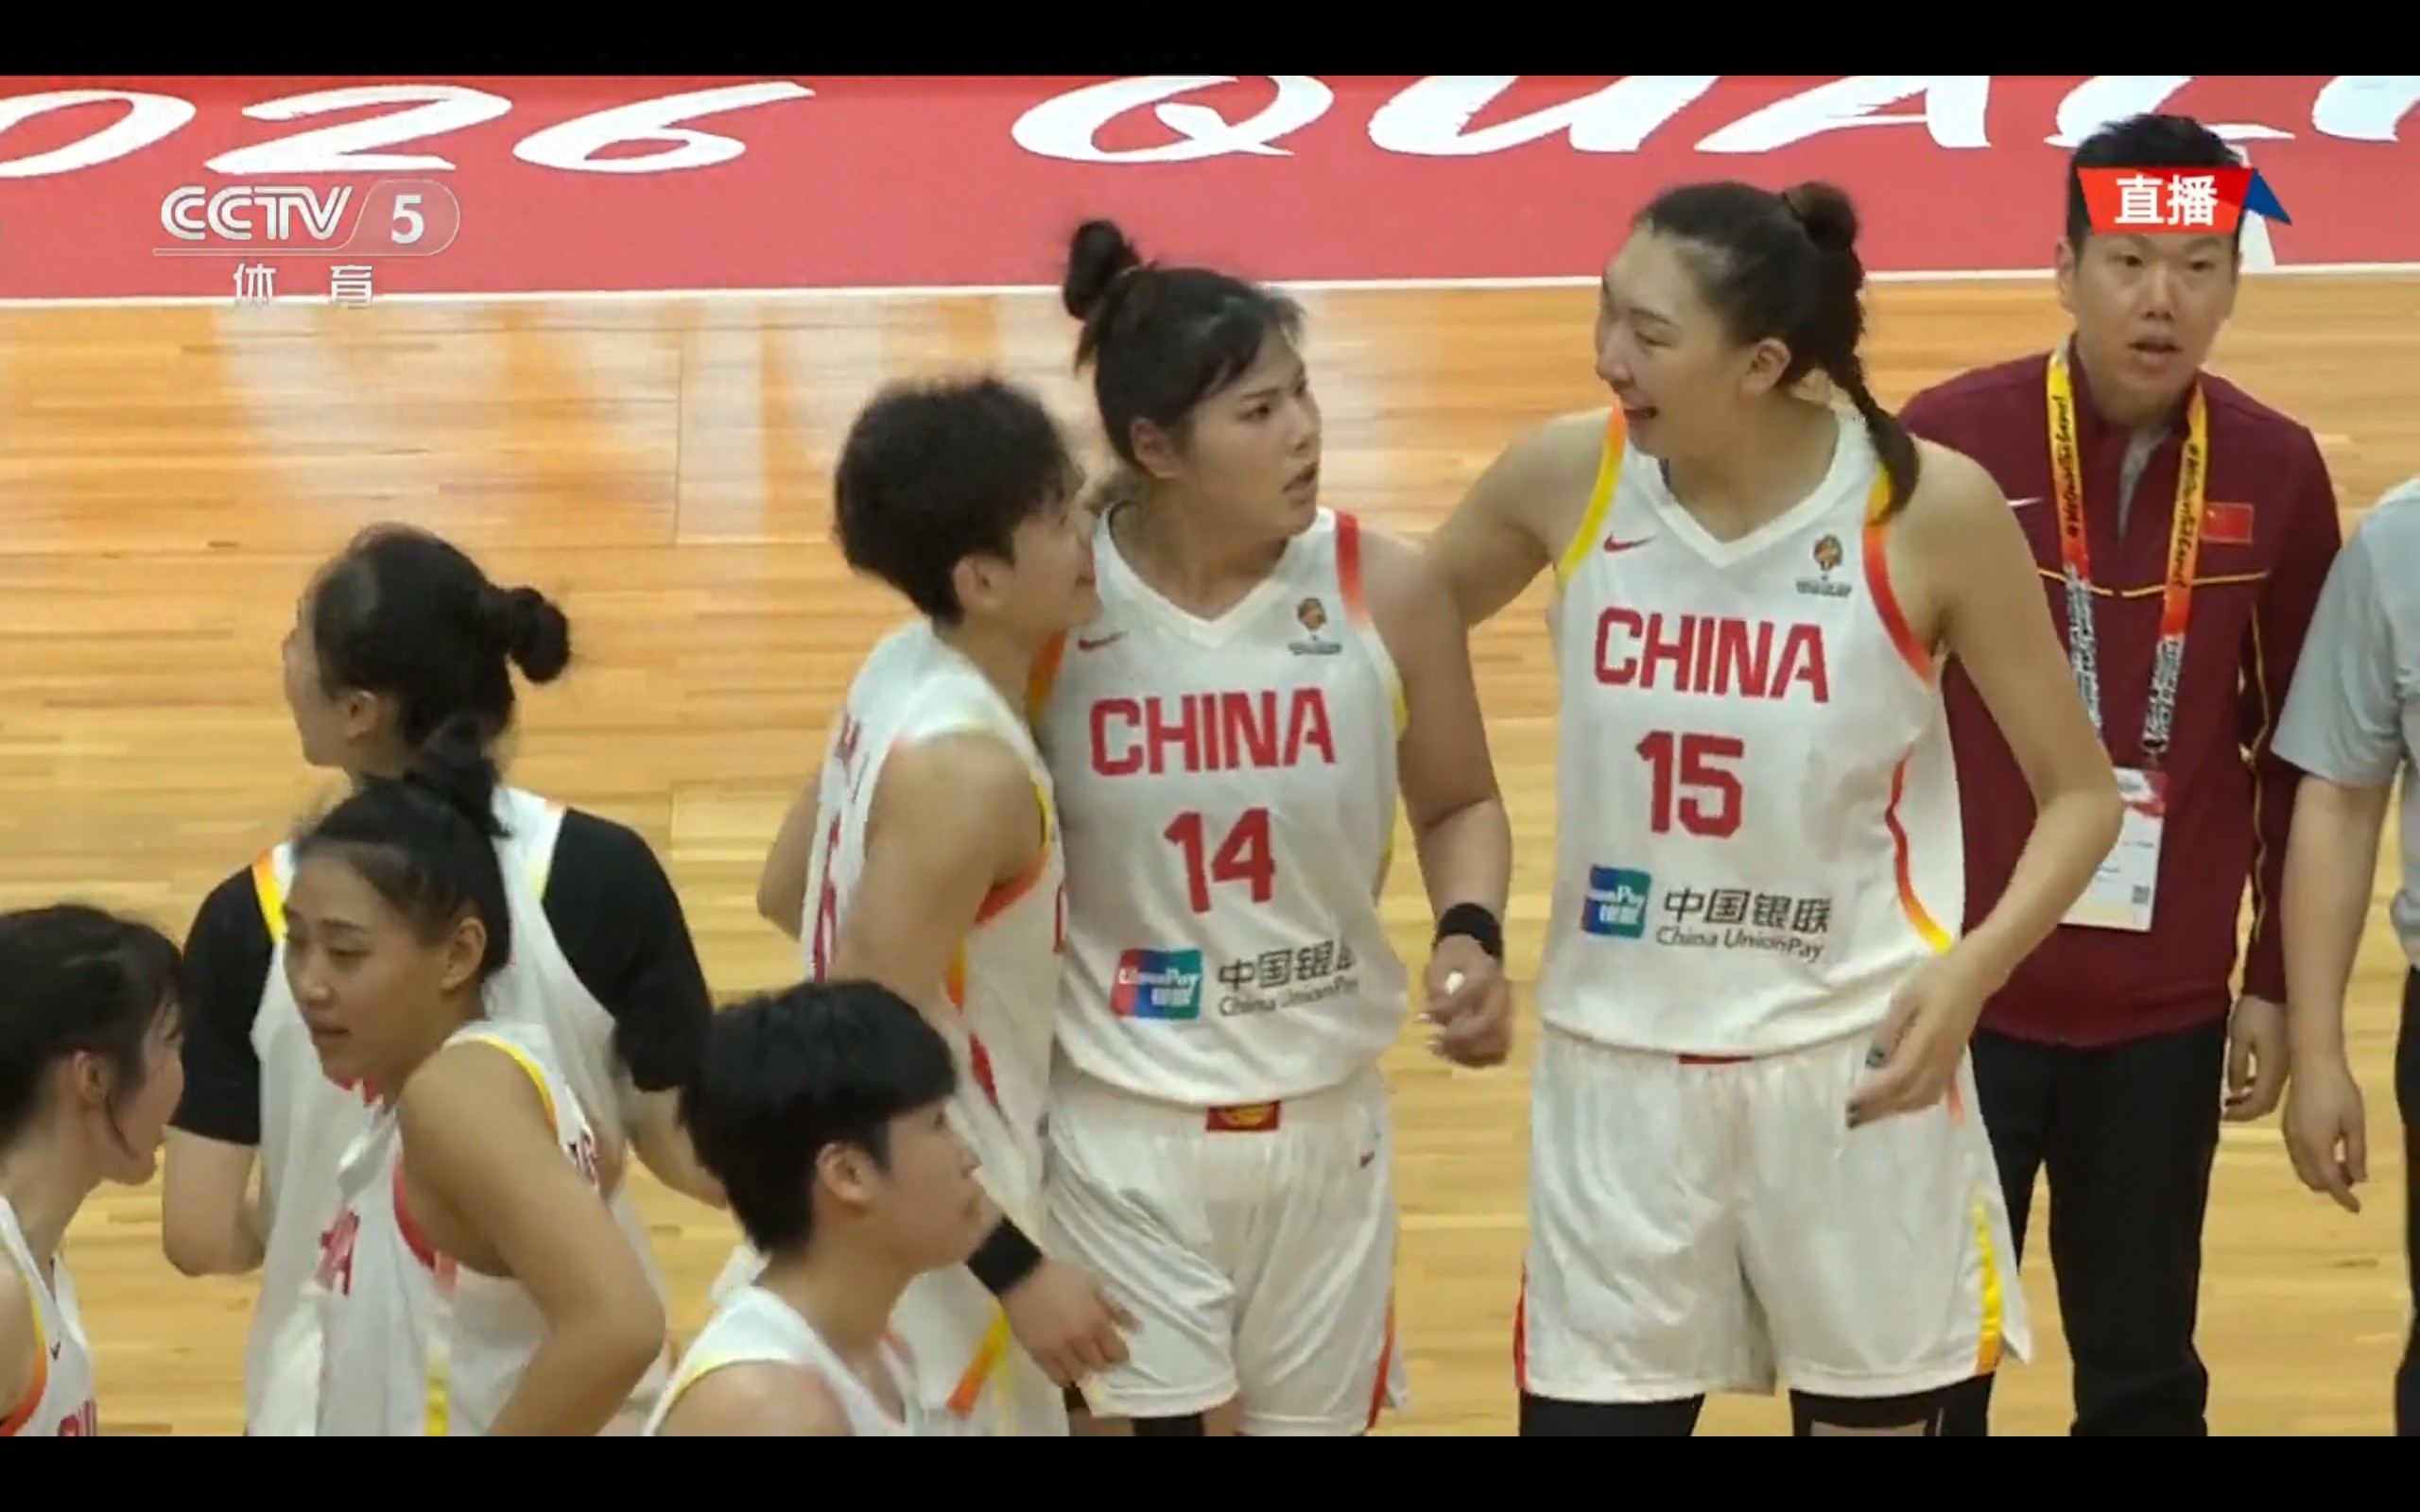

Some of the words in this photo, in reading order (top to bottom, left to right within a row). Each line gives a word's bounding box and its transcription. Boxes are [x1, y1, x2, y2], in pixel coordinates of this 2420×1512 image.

[1595, 606, 1830, 703] CHINA
[1089, 688, 1337, 776] CHINA
[1635, 730, 1745, 839] 15
[1164, 808, 1276, 914] 14
[1657, 926, 1718, 947] China
[1723, 928, 1824, 963] UnionPay
[1664, 887, 1831, 934] 中国银联
